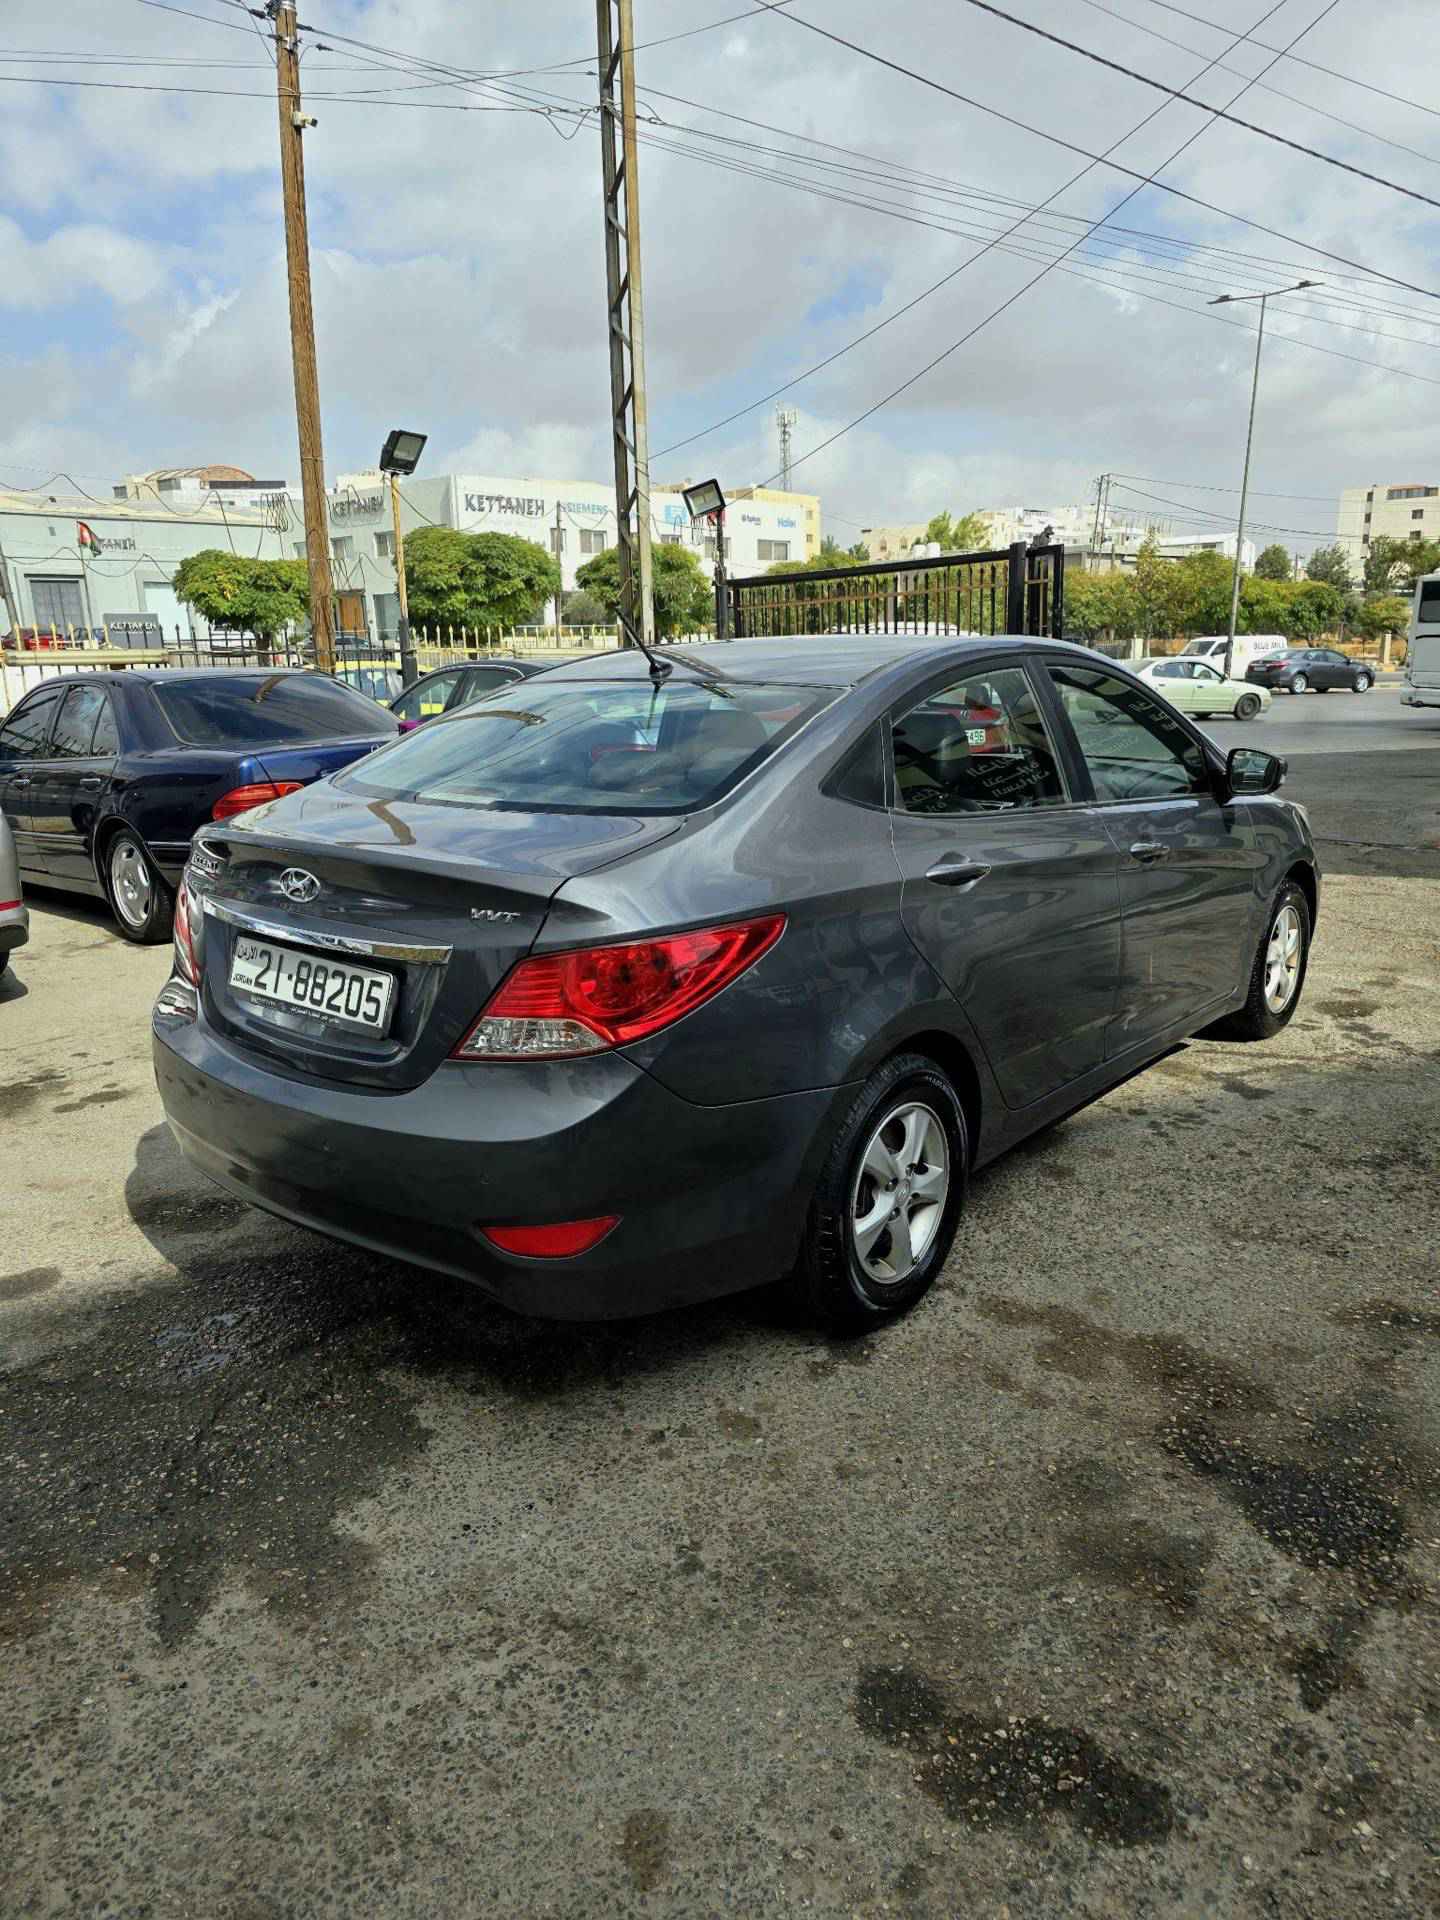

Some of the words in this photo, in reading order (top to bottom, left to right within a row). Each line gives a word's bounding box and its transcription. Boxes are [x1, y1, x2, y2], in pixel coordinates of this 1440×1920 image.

[465, 493, 545, 516] KETTANEH
[567, 503, 609, 516] SIEMENS
[1253, 642, 1270, 650] BLUE
[471, 908, 521, 923] VVT
[233, 973, 253, 986] JORDAN
